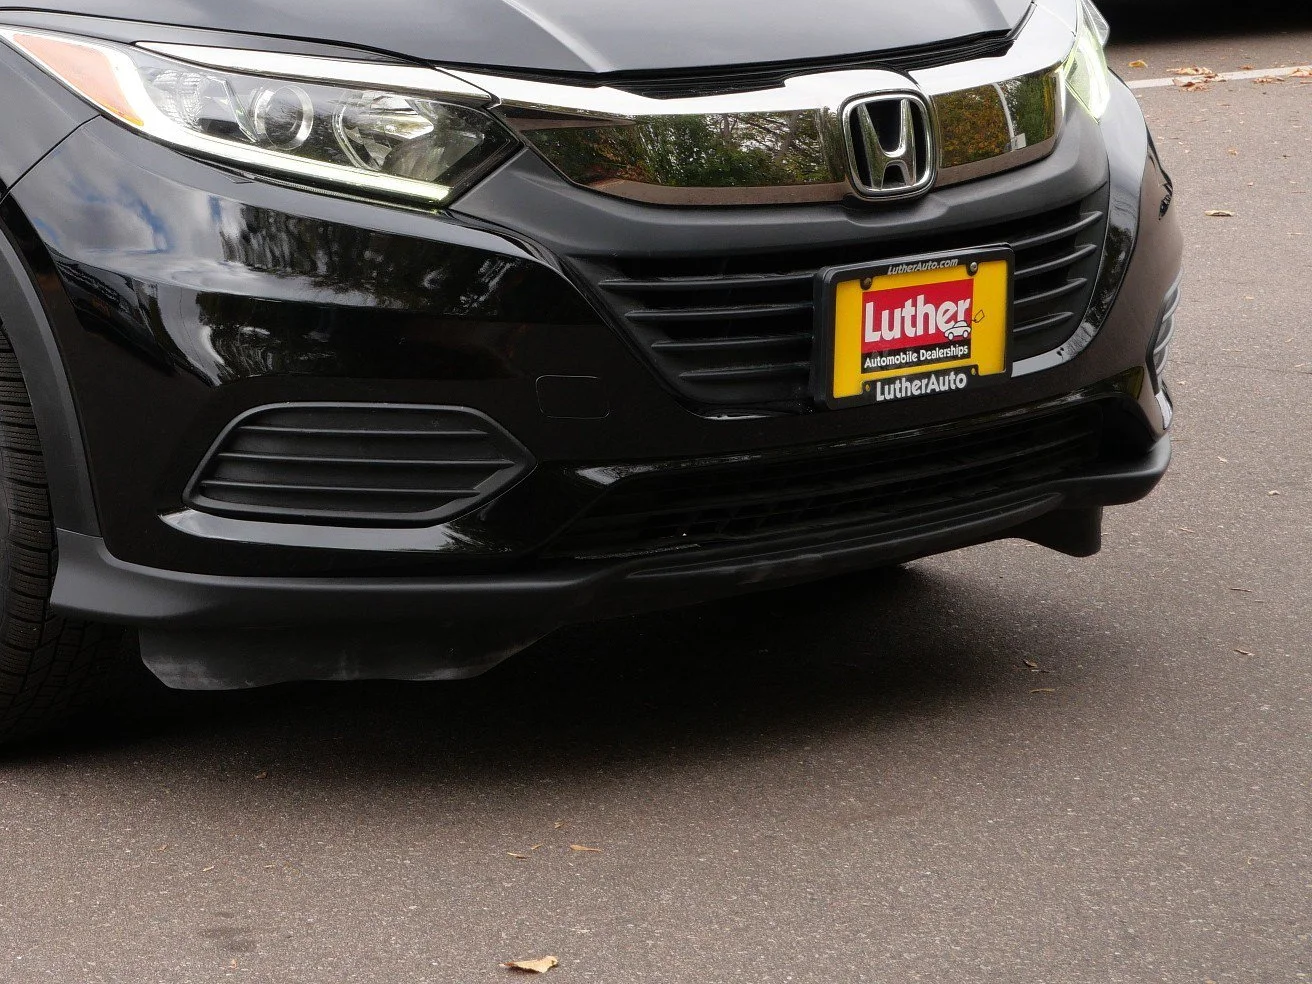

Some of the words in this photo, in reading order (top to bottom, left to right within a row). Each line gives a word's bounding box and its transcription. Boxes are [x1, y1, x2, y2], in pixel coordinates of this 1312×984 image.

[888, 257, 958, 275] LutherAuto.com
[864, 294, 971, 343] Luther
[864, 350, 918, 369] Automobile
[919, 344, 969, 361] Dealerships
[876, 372, 967, 401] LutherAuto
